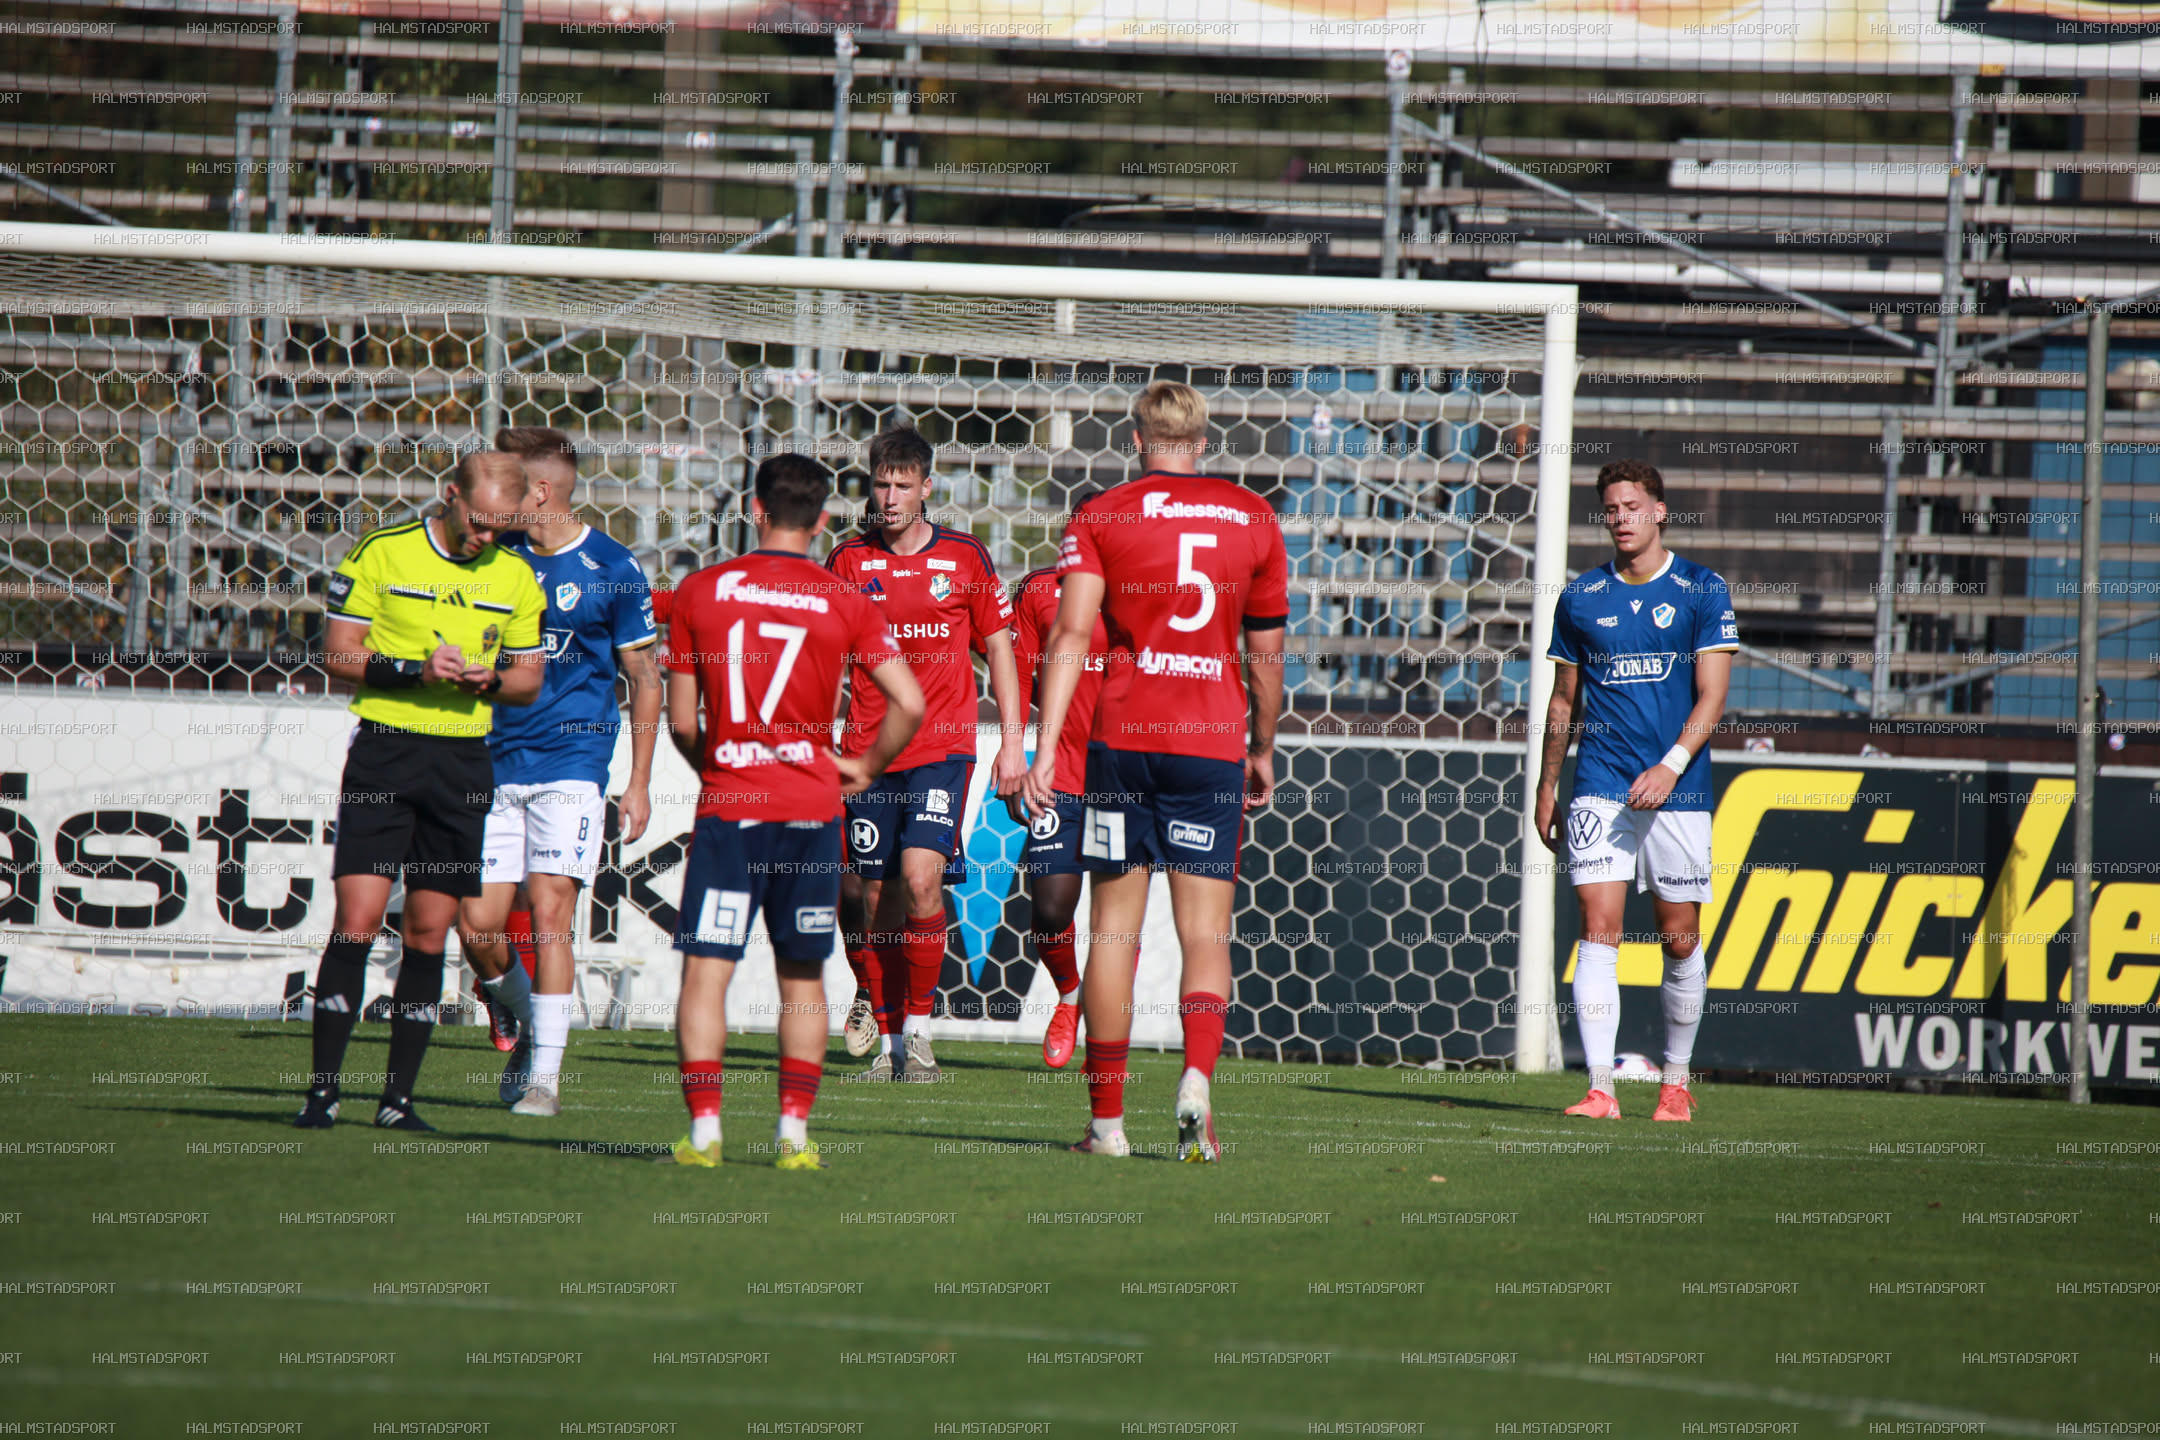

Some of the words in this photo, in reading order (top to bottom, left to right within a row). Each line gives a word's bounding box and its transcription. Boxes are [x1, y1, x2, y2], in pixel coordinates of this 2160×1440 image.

[1150, 497, 1250, 526] Fellessons
[1167, 532, 1218, 633] 5
[727, 618, 808, 726] 17
[1612, 658, 1663, 678] JONAB
[577, 816, 590, 842] 8
[915, 813, 954, 827] BALCO
[1173, 826, 1209, 845] griffel
[1657, 876, 1699, 887] villalivet
